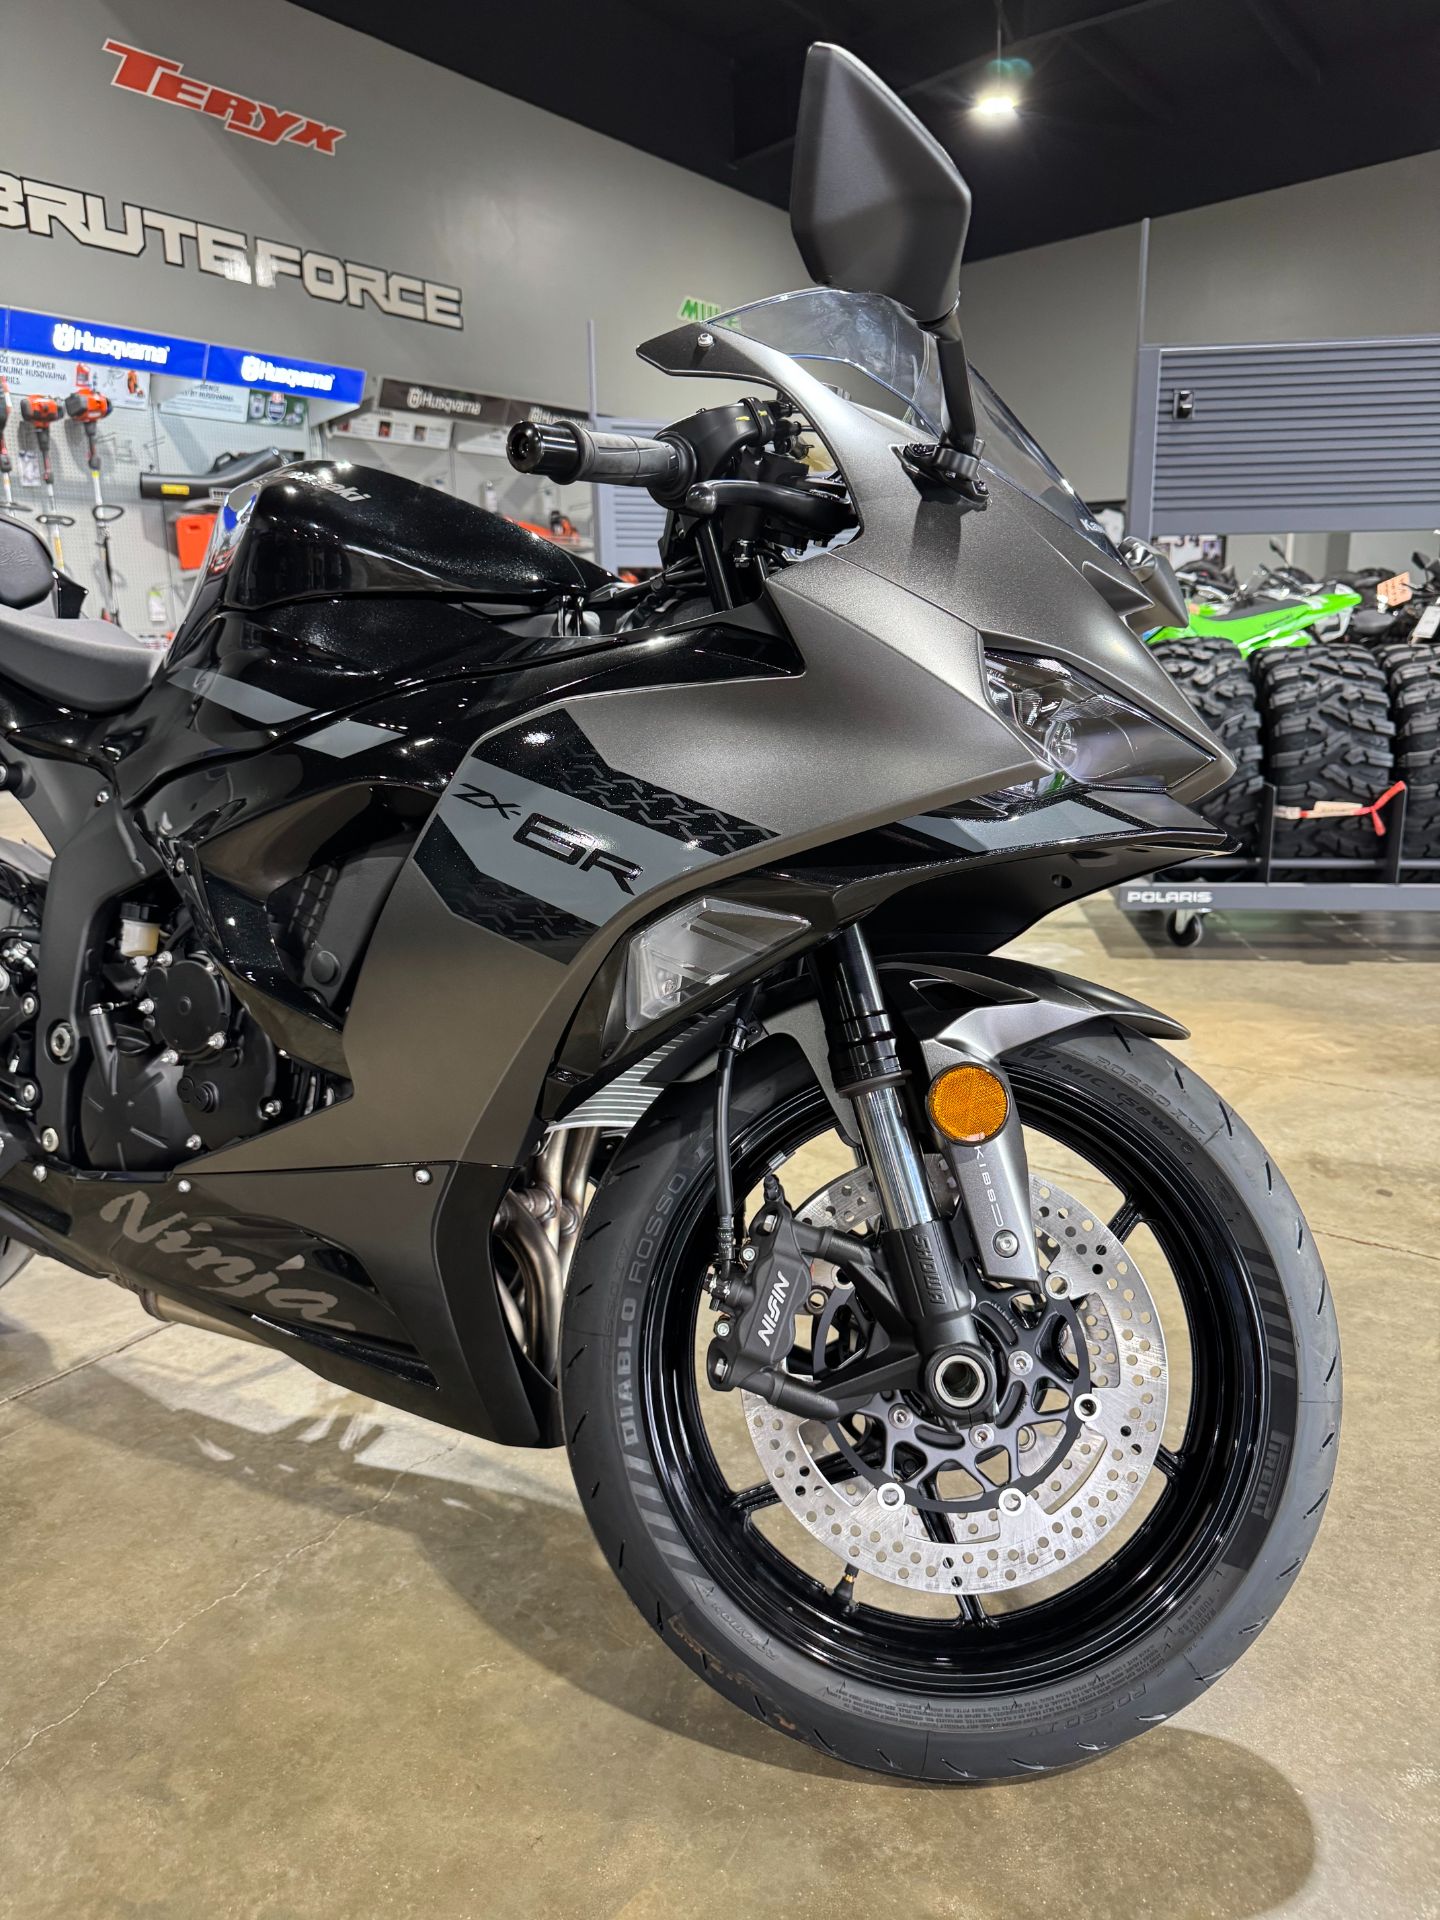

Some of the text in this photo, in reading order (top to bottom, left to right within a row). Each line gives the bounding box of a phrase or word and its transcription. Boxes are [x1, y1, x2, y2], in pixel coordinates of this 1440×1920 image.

[254, 236, 464, 330] FORCE
[74, 328, 170, 364] Husqvarna
[258, 360, 335, 391] Husqvarna
[421, 393, 483, 416] Husqvarna
[1127, 890, 1213, 904] POLARIS
[100, 1190, 356, 1332] Ninja
[913, 1233, 947, 1305] SHOWA
[615, 1172, 687, 1447] DIABLO ROSSO
[757, 1270, 791, 1347] NISSIN
